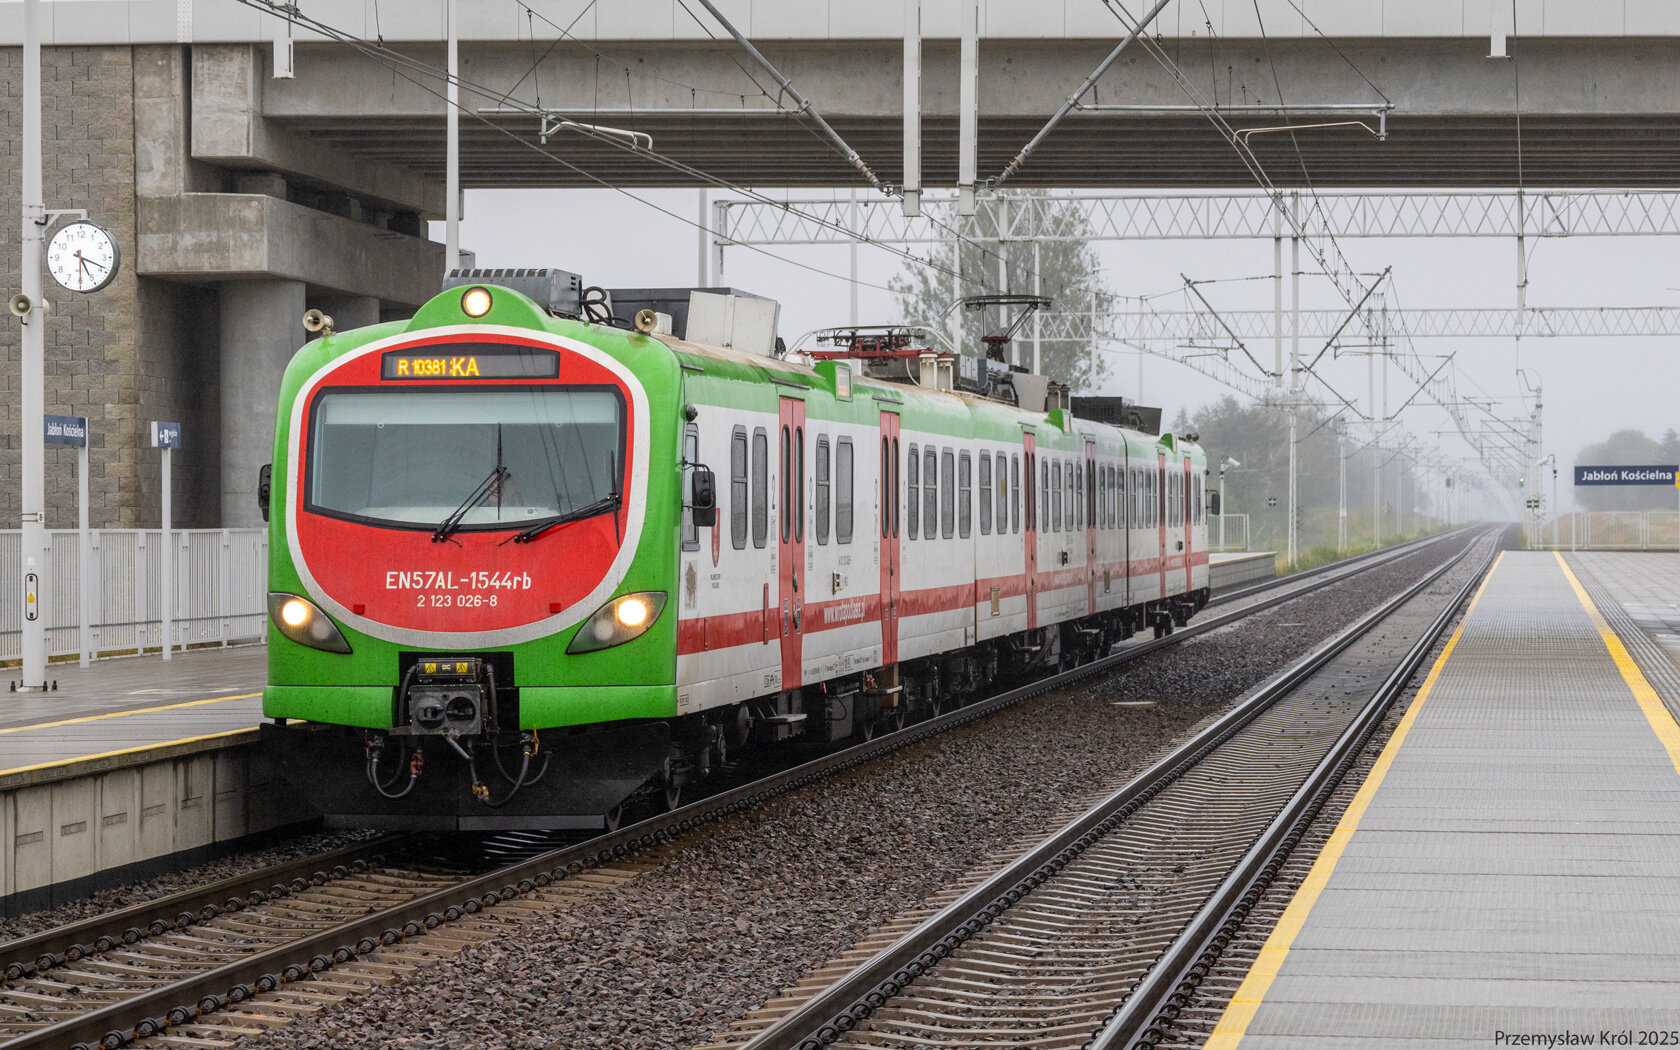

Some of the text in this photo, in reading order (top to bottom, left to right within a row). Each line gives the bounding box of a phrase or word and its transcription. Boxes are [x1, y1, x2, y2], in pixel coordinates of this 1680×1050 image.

[77, 231, 86, 239] 12
[398, 359, 409, 375] R
[411, 359, 446, 375] 10381
[1582, 469, 1672, 481] Jabłoń Kościelna
[386, 571, 531, 590] EN57AL-1544rb
[417, 595, 498, 607] 2 123 026-8
